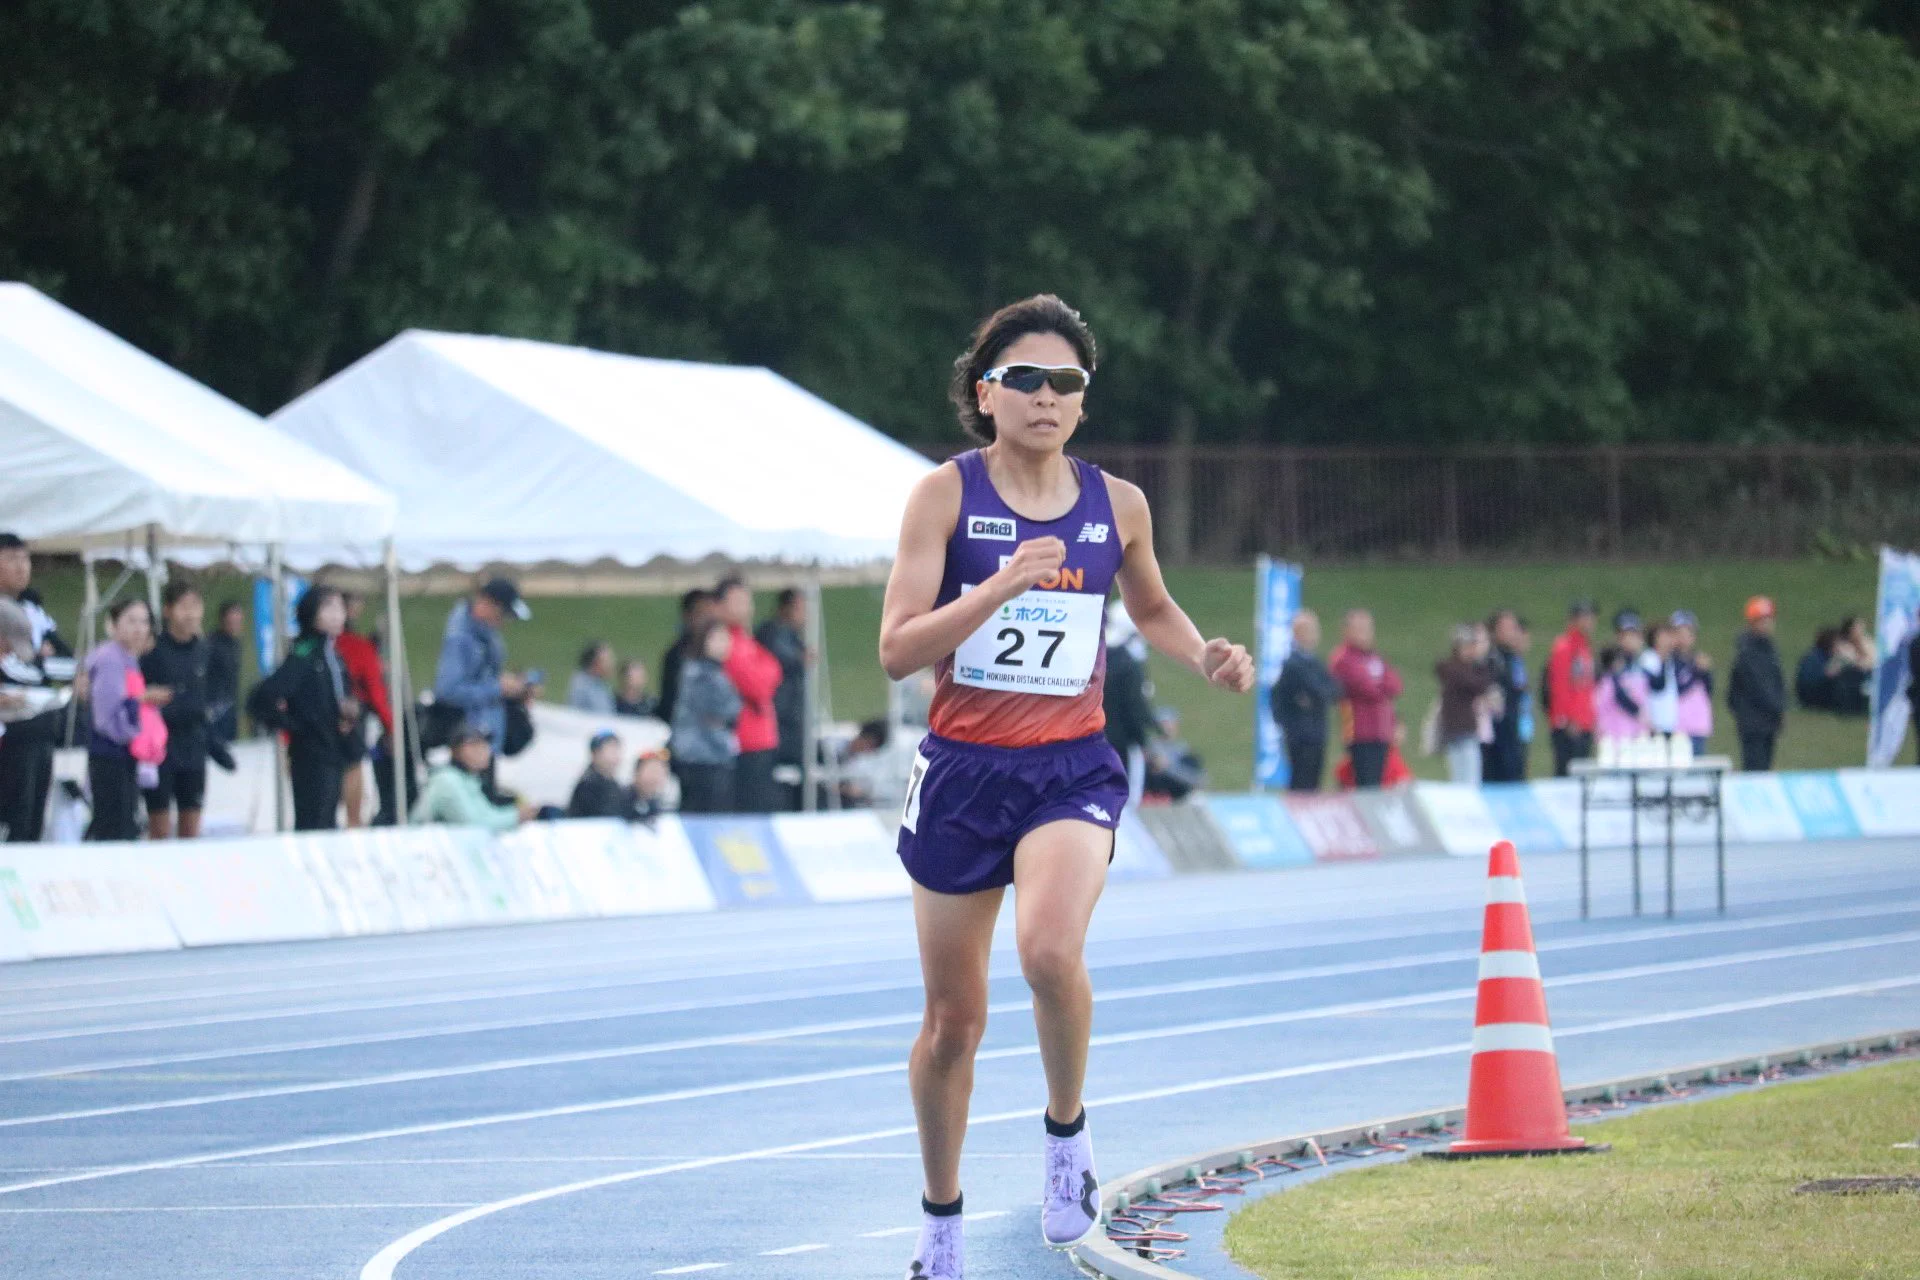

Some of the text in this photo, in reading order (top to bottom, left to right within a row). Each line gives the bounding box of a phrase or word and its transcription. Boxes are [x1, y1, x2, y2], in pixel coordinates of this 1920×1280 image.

[1015, 606, 1068, 623] ホクレン
[994, 627, 1066, 668] 27
[986, 671, 1015, 682] HOKUREN
[1016, 675, 1046, 686] DISTANCE
